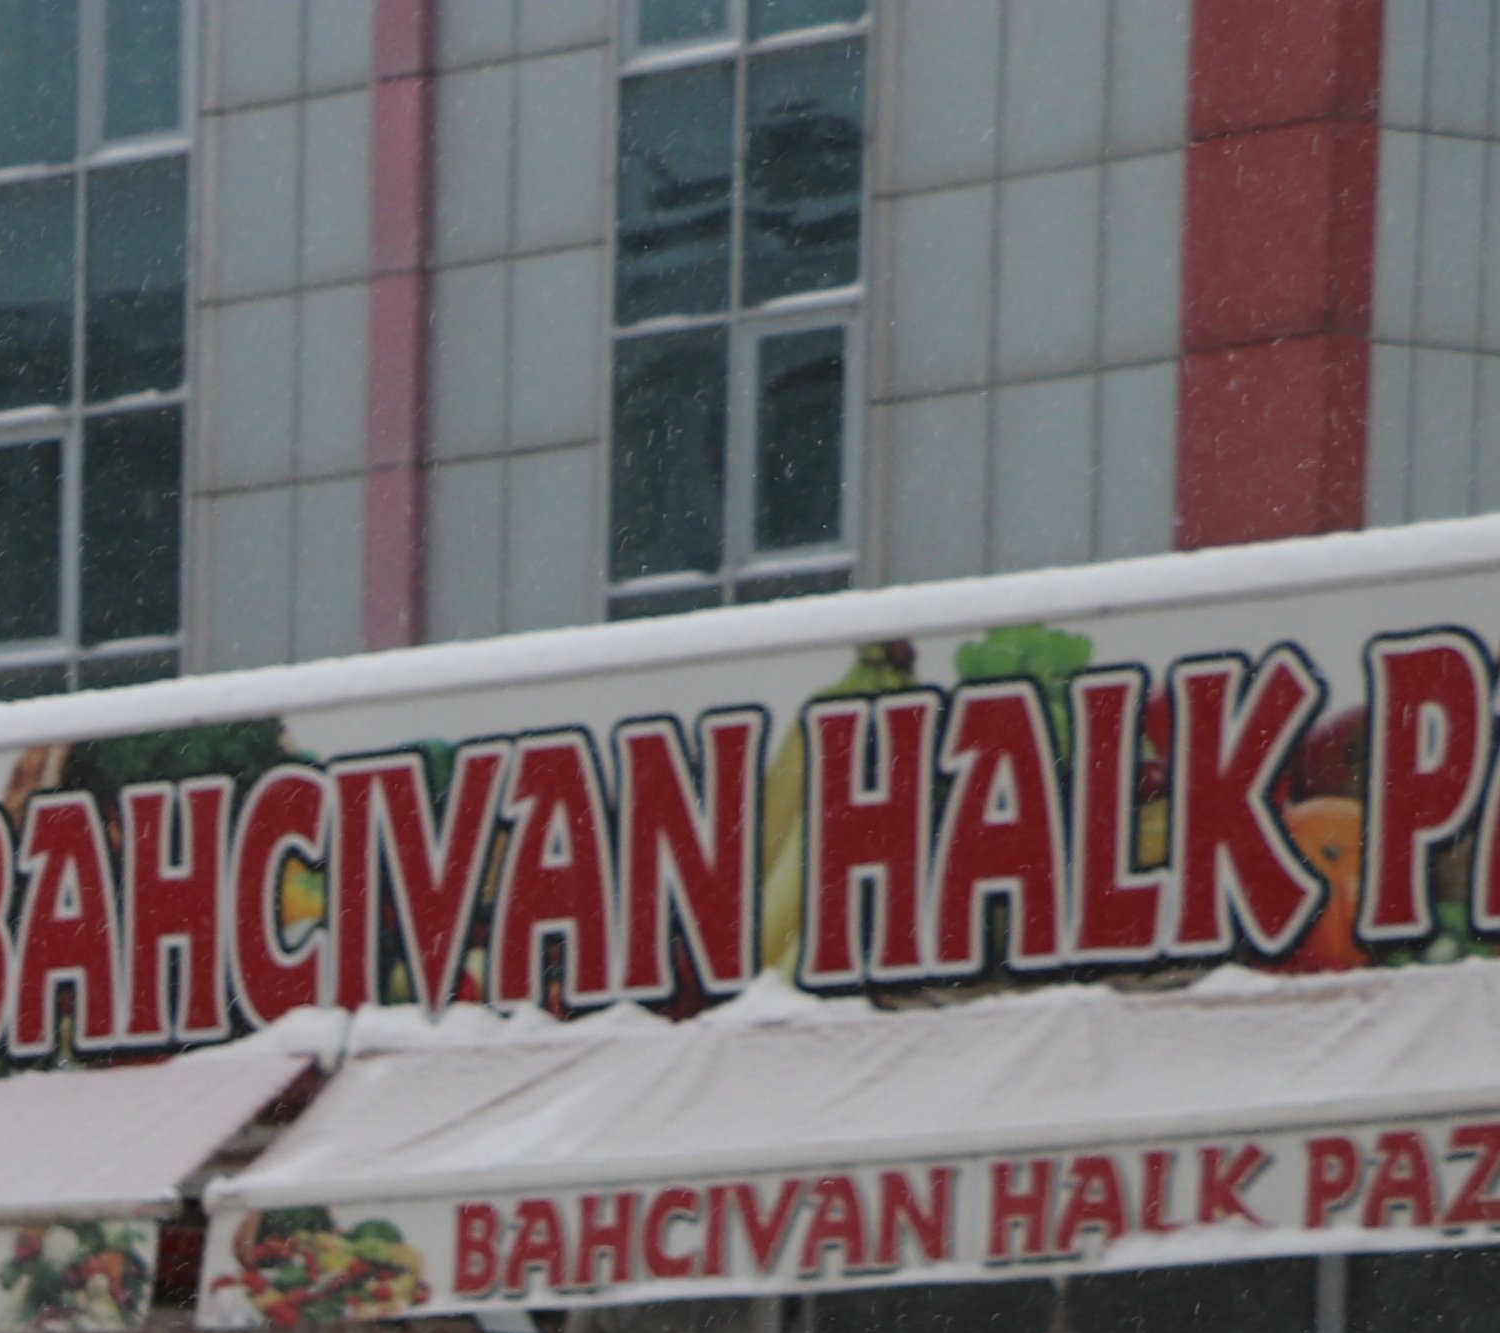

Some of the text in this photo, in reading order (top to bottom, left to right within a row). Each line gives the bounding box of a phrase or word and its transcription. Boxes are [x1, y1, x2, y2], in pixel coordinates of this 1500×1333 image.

[798, 640, 1330, 997] HALK
[1356, 626, 1500, 950] P
[452, 1123, 1500, 1297] BAHCIVAN HALK PAZ
